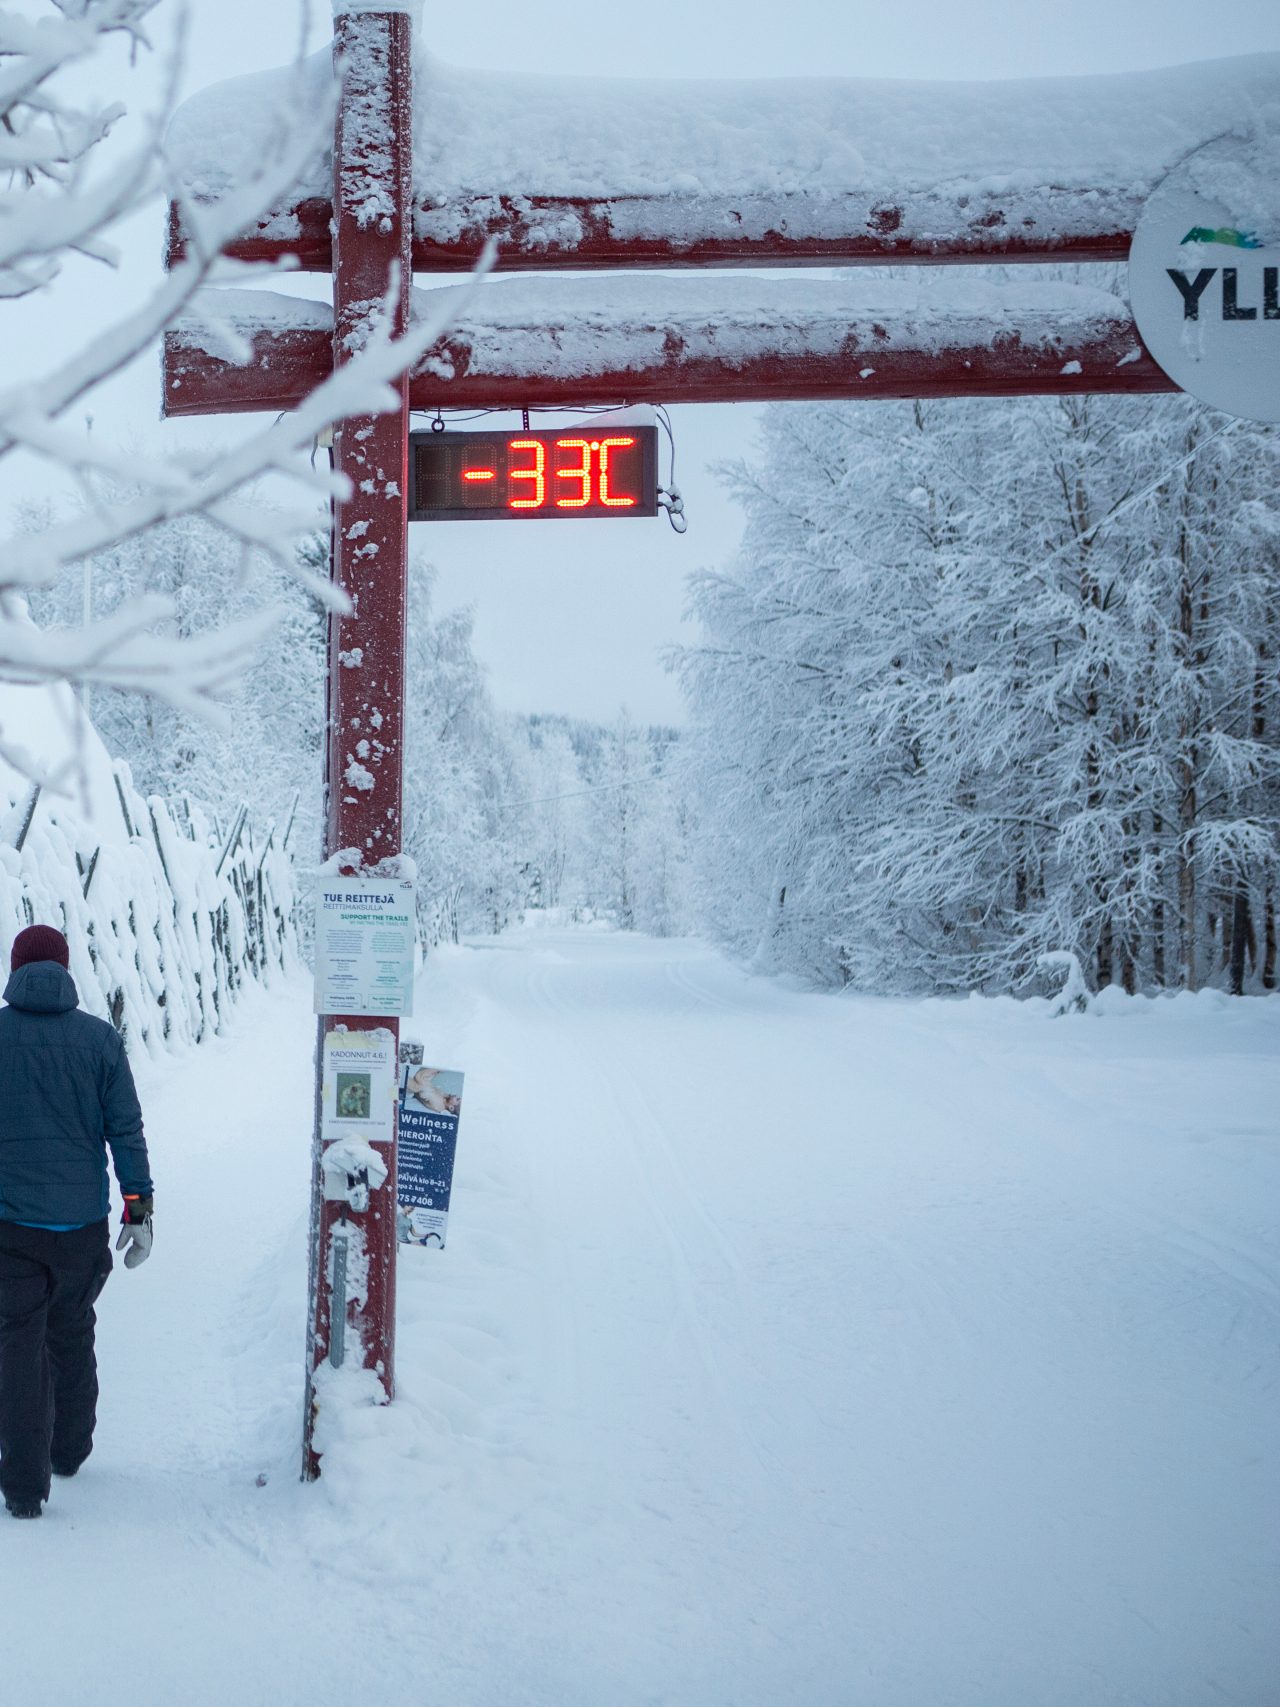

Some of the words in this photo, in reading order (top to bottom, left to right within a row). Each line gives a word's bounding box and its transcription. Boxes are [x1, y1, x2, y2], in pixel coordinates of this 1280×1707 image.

[323, 893, 343, 902] TUE
[345, 893, 395, 904] REITTEJÄ
[323, 903, 384, 911] REITTIMAKSULLA
[330, 1051, 371, 1059] KADONNUT
[401, 1113, 454, 1130] Wellness
[398, 1129, 443, 1143] HIERONTA
